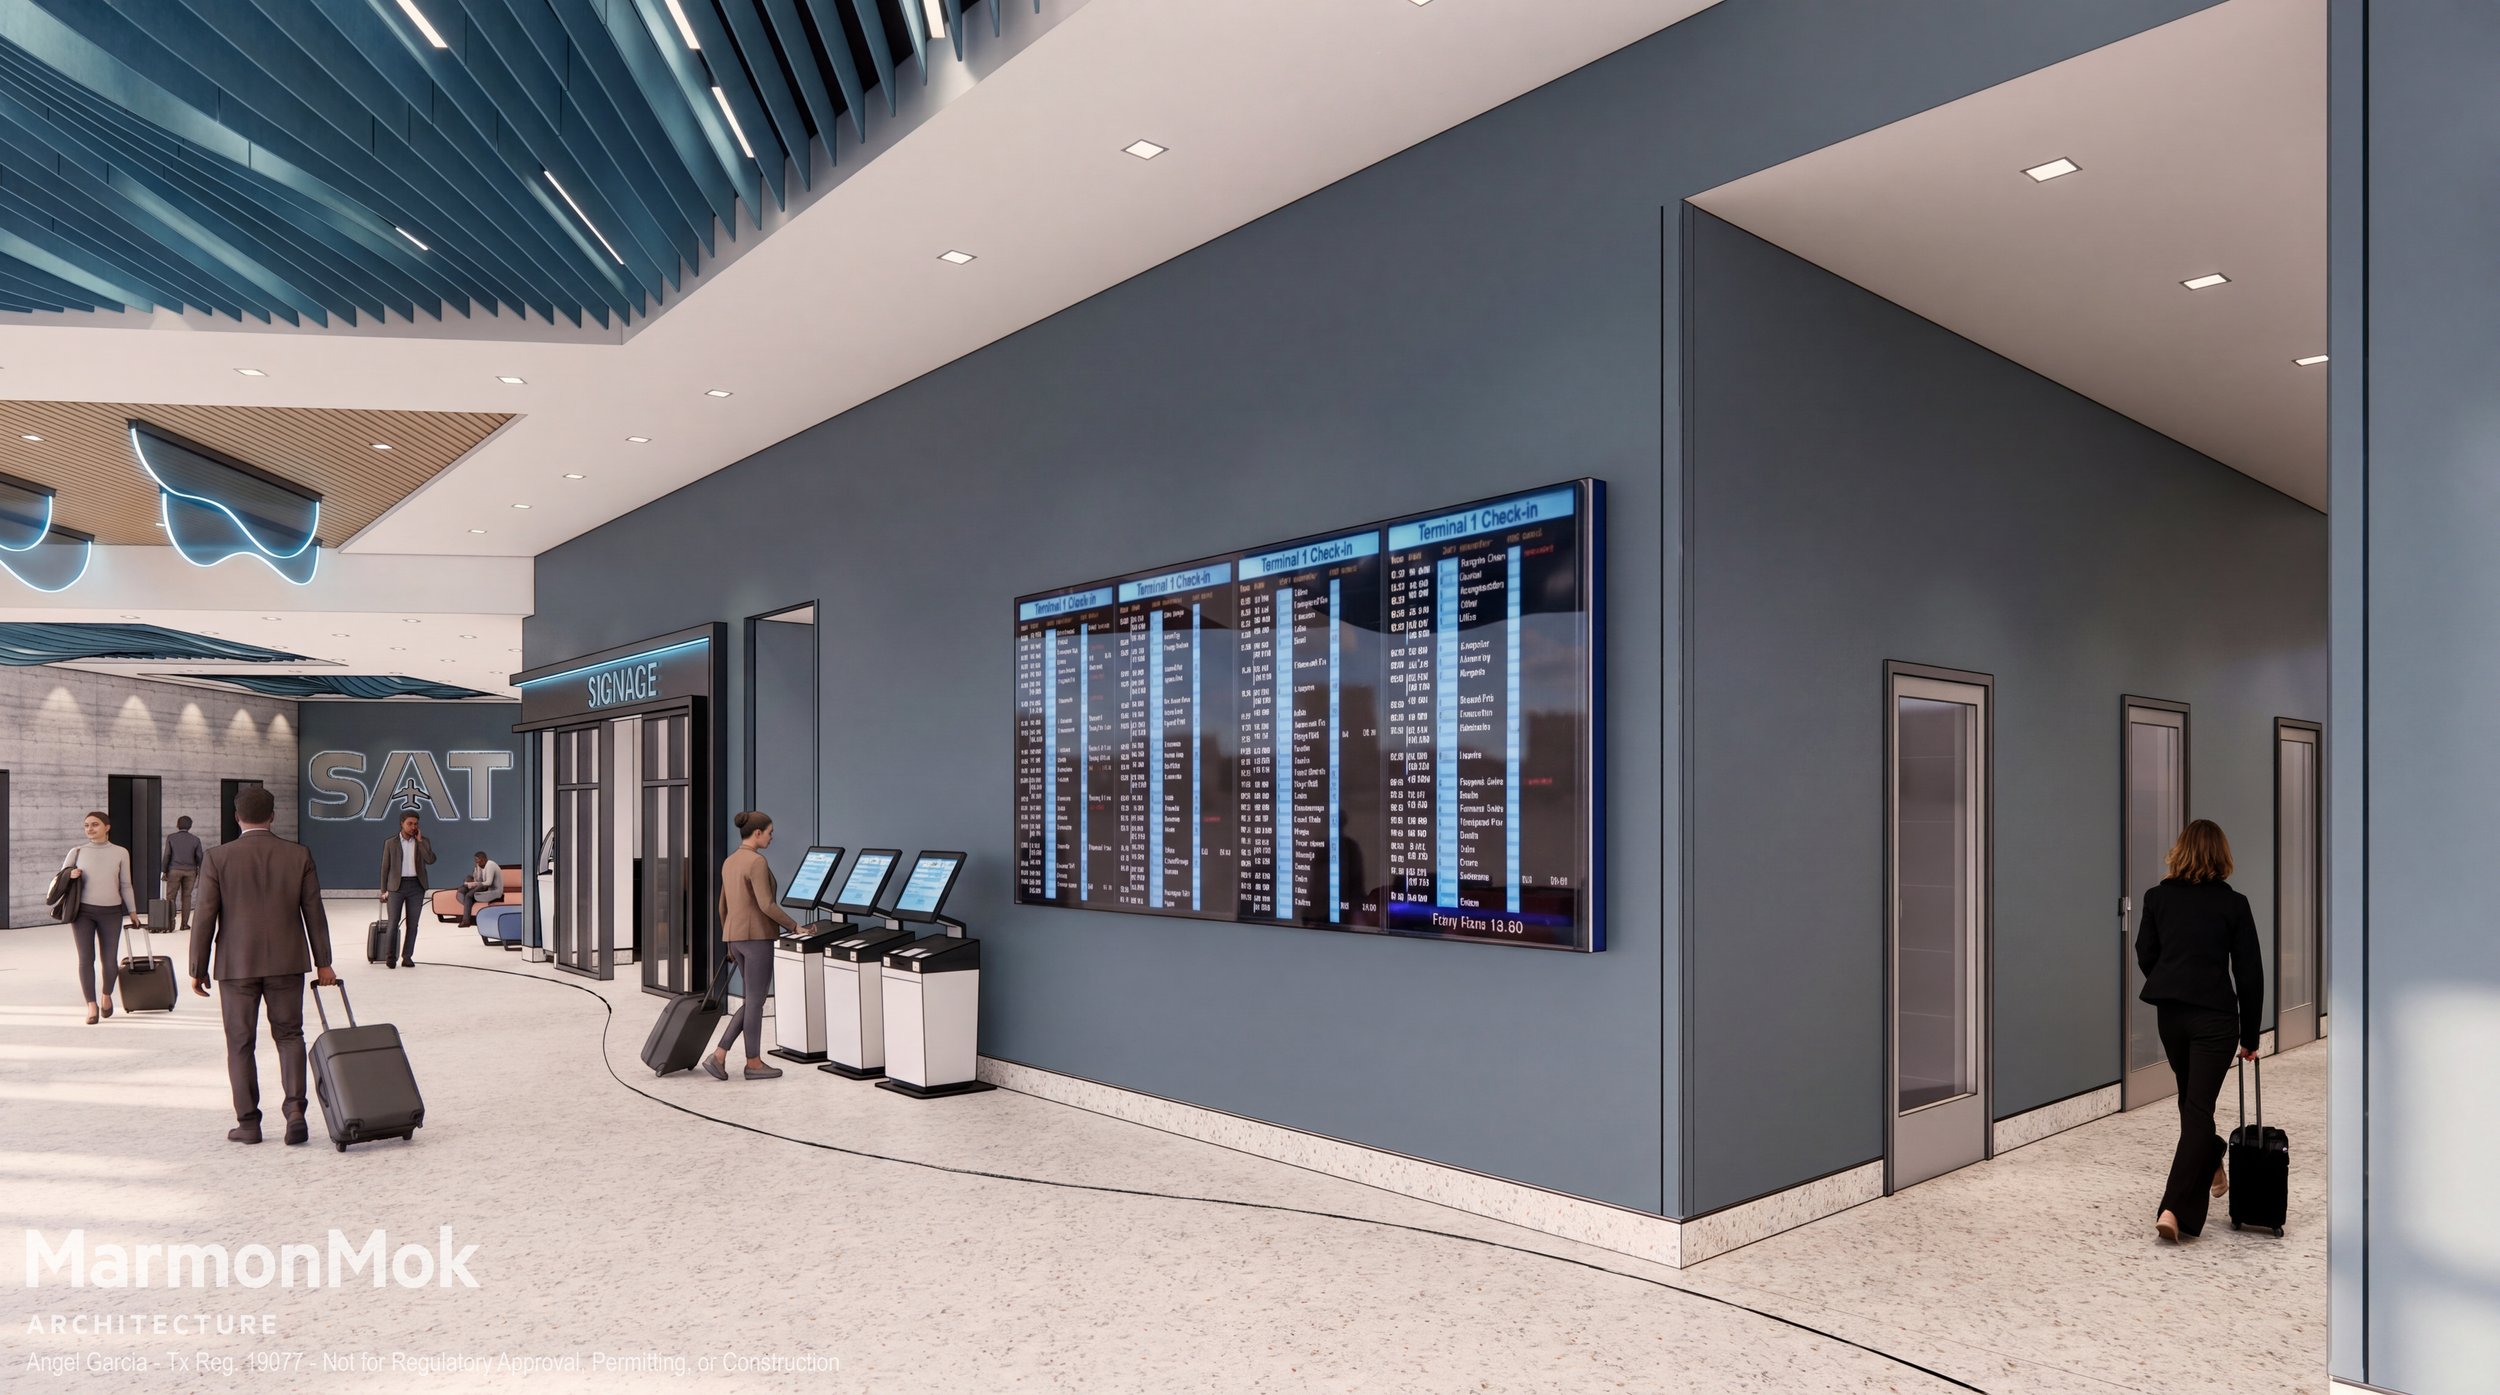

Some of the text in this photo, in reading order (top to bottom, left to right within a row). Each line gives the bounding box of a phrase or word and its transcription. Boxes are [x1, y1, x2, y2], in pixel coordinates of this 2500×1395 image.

[1418, 500, 1538, 541] Terminal 1 Check-in
[1261, 540, 1353, 572] Terminal 1 Check-in
[588, 661, 658, 708] SIGNAGE
[309, 751, 513, 820] SAT
